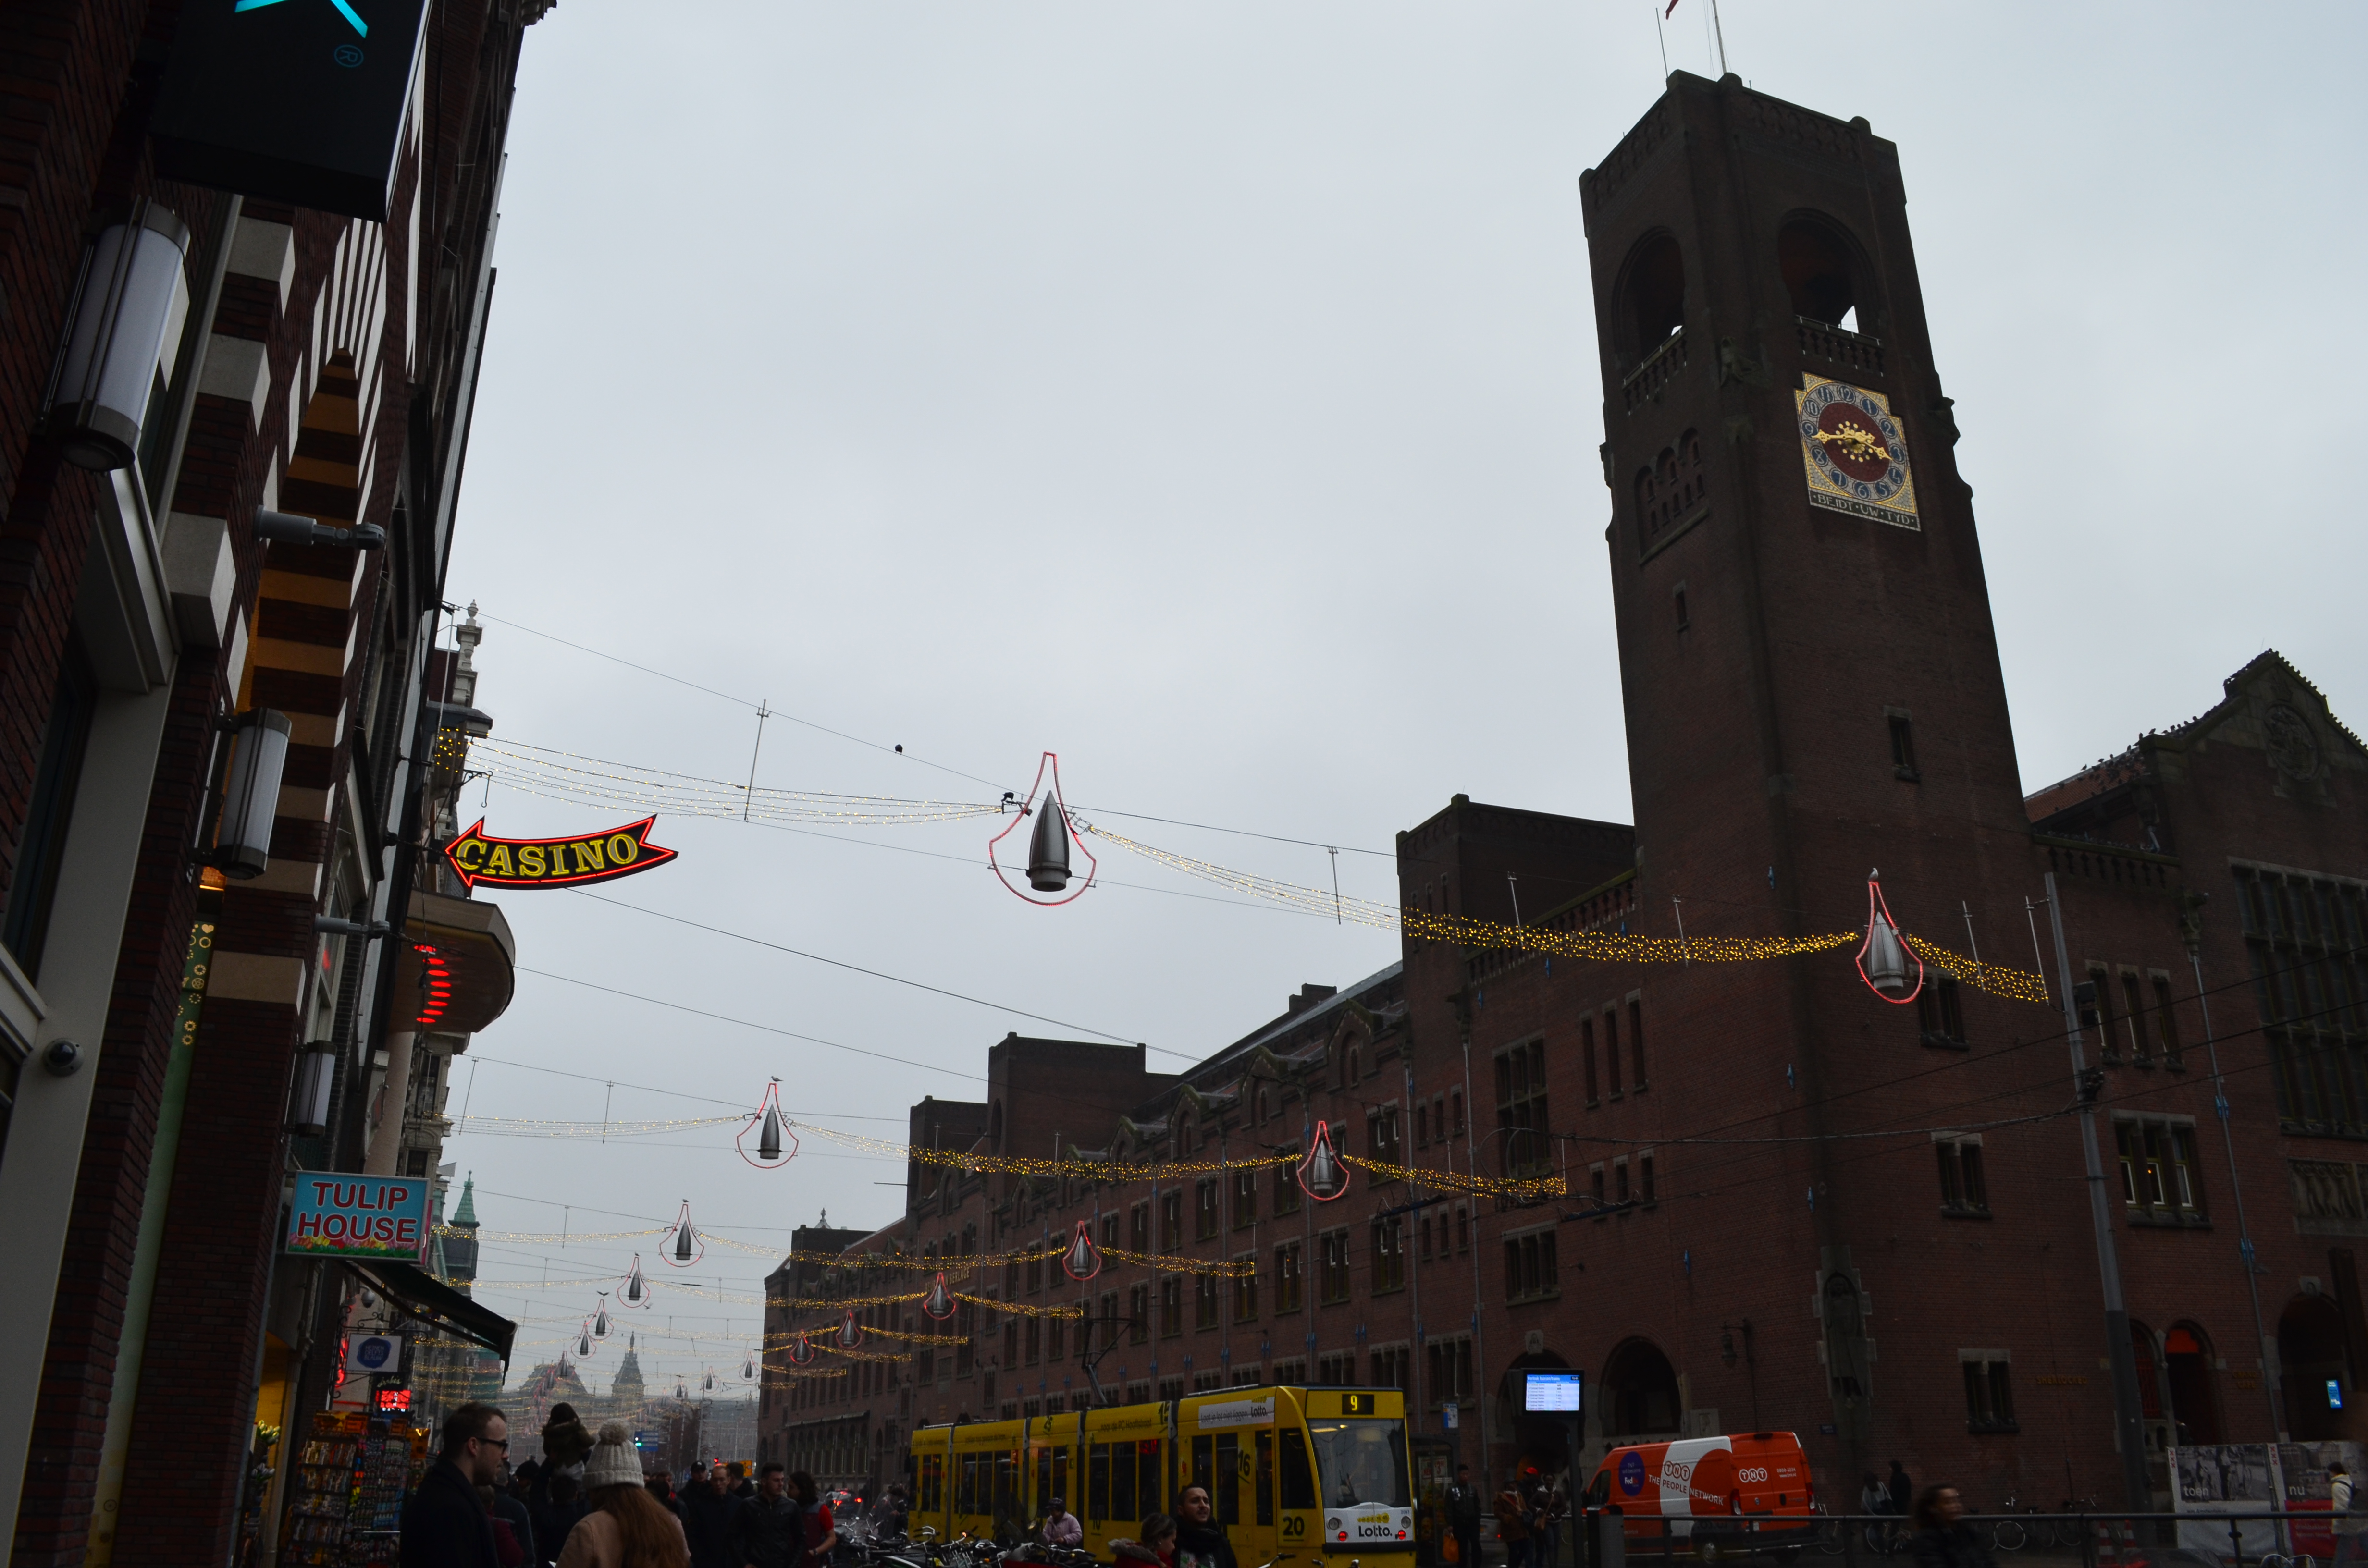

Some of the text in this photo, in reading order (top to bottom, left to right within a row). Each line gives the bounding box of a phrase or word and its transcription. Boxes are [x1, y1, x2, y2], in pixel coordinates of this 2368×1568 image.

[1820, 387, 1830, 402] 11
[1841, 386, 1852, 400] 12
[1806, 400, 1817, 416] 10
[1867, 400, 1872, 413] 1
[1805, 423, 1813, 436] 9
[1885, 422, 1893, 436] 2
[1816, 448, 1825, 465] 8
[1893, 447, 1902, 461] 3
[1834, 471, 1842, 486] 7
[1892, 470, 1900, 484] 4
[1858, 486, 1866, 499] 6
[1878, 482, 1887, 496] 5
[1818, 495, 1910, 524] BEIDT UW TYD
[456, 833, 639, 877] CASINO
[312, 1181, 408, 1211] TULIP
[297, 1212, 418, 1243] HOUSE
[2037, 1374, 2088, 1384] SHERLOCKED
[1350, 1395, 1358, 1411] 9
[1238, 1449, 1251, 1477] 16
[1665, 1462, 1689, 1479] TNT
[1740, 1469, 1766, 1482] TNT
[1648, 1474, 1724, 1506] THE PEOPLE NETWORK
[2183, 1485, 2209, 1497] toen
[2289, 1485, 2306, 1496] nu
[1283, 1516, 1304, 1536] 20
[1358, 1525, 1393, 1537] Lotto.
